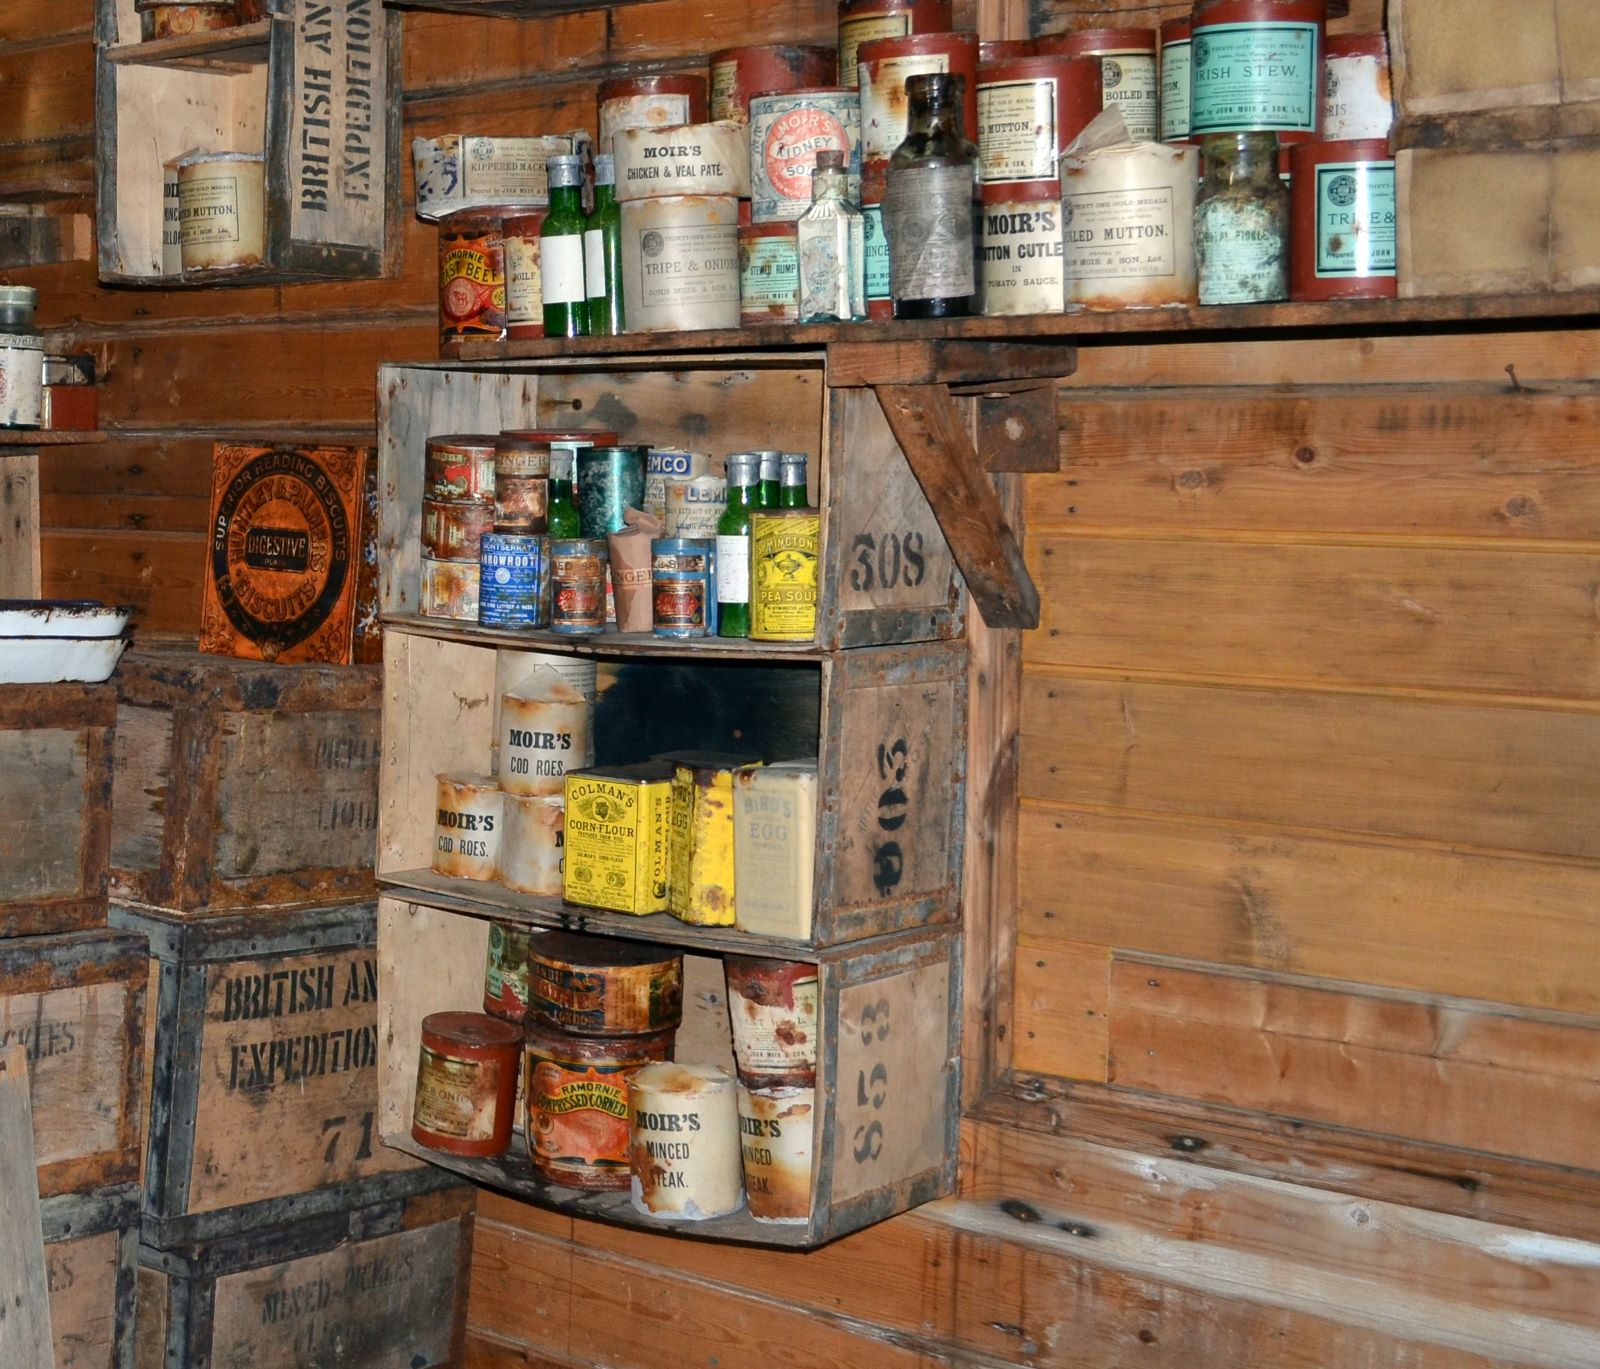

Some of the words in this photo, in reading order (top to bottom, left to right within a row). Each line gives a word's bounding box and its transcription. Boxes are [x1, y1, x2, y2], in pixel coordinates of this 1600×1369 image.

[1195, 67, 1231, 82] IRISH
[1243, 65, 1299, 78] STEW.
[1105, 90, 1143, 101] BOILED
[1215, 106, 1232, 114] JOHN
[988, 121, 1033, 134] MUTTON.
[299, 66, 330, 210] BRITISH
[643, 145, 702, 159] MOIR'S
[471, 161, 518, 171] KIPPERED
[627, 165, 660, 180] CHICKEN
[663, 165, 672, 178] &
[675, 164, 697, 177] VEAL
[193, 205, 236, 217] MUTTON.
[1327, 212, 1381, 225] TRIE
[988, 212, 1056, 236] MOIR'S
[1103, 224, 1169, 241] MUTTON.
[1370, 248, 1391, 257] JOHN
[645, 260, 682, 275] TRIPE
[688, 260, 699, 272] &
[776, 264, 797, 275] RUMP
[988, 279, 1017, 288] TOMATO
[687, 486, 727, 503] LEM
[255, 455, 315, 479] READING
[315, 476, 347, 561] BISCUITS
[230, 478, 275, 565] HUNTLEY
[289, 483, 328, 574] PALMERS
[248, 534, 306, 559] DIGESTIVE
[234, 576, 319, 621] BISCUITS
[761, 592, 782, 602] PEA
[509, 728, 572, 750] MOIR'S
[510, 756, 529, 774] COD
[571, 783, 635, 808] COLMAN'S
[437, 809, 494, 831] MOIR'S
[569, 819, 635, 838] CORN-FLOUR
[750, 823, 788, 841] EGG
[438, 836, 453, 853] COD
[459, 840, 489, 858] ROES.
[652, 797, 667, 898] COLMAN'S
[223, 964, 335, 1022] BRITISH
[560, 1083, 622, 1099] RAMORNIE
[589, 1093, 627, 1116] CORNED
[636, 1110, 701, 1132] MOIR'S
[741, 1116, 781, 1138] OIR'S
[646, 1140, 690, 1160] MINCED
